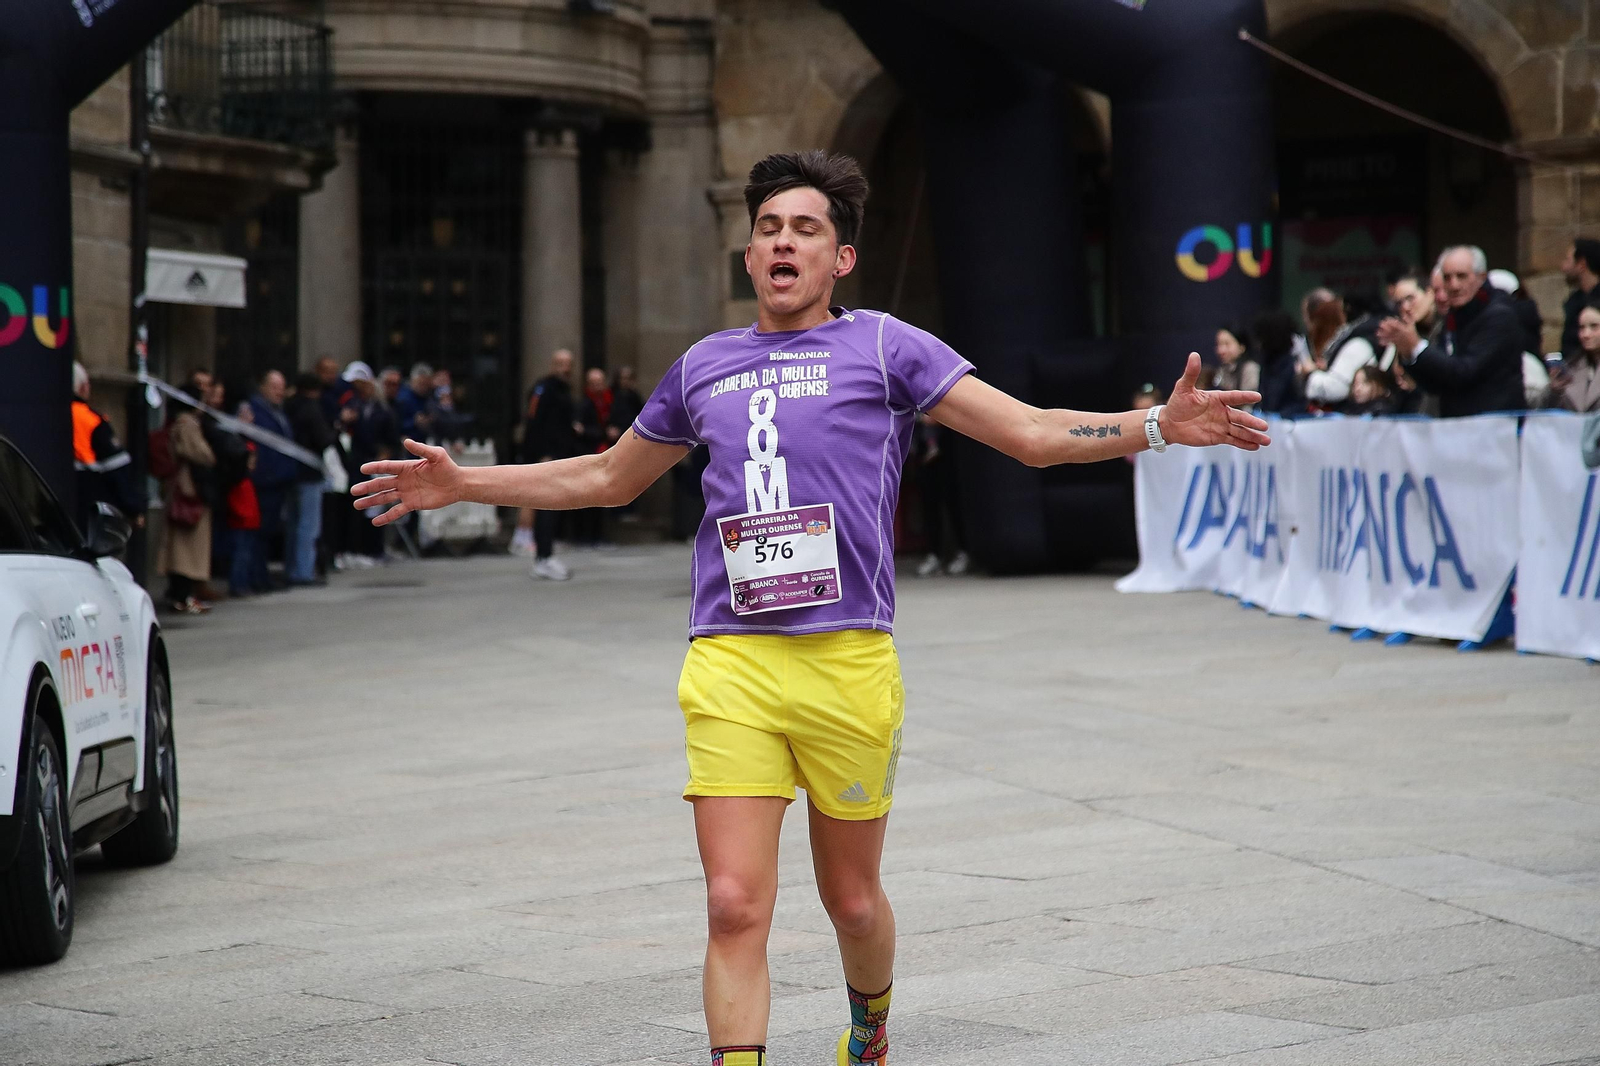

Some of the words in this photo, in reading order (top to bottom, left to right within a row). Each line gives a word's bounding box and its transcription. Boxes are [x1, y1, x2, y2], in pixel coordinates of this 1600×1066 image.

[710, 369, 759, 399] CARREIRA
[762, 367, 778, 386] DA
[781, 364, 827, 383] MULLER
[778, 380, 830, 399] OURENSE
[751, 517, 787, 526] CARREIRA
[787, 513, 799, 521] DA
[740, 528, 767, 538] MULLER
[768, 522, 803, 534] OURENSE
[755, 541, 794, 564] 576
[811, 574, 835, 582] OURENSE
